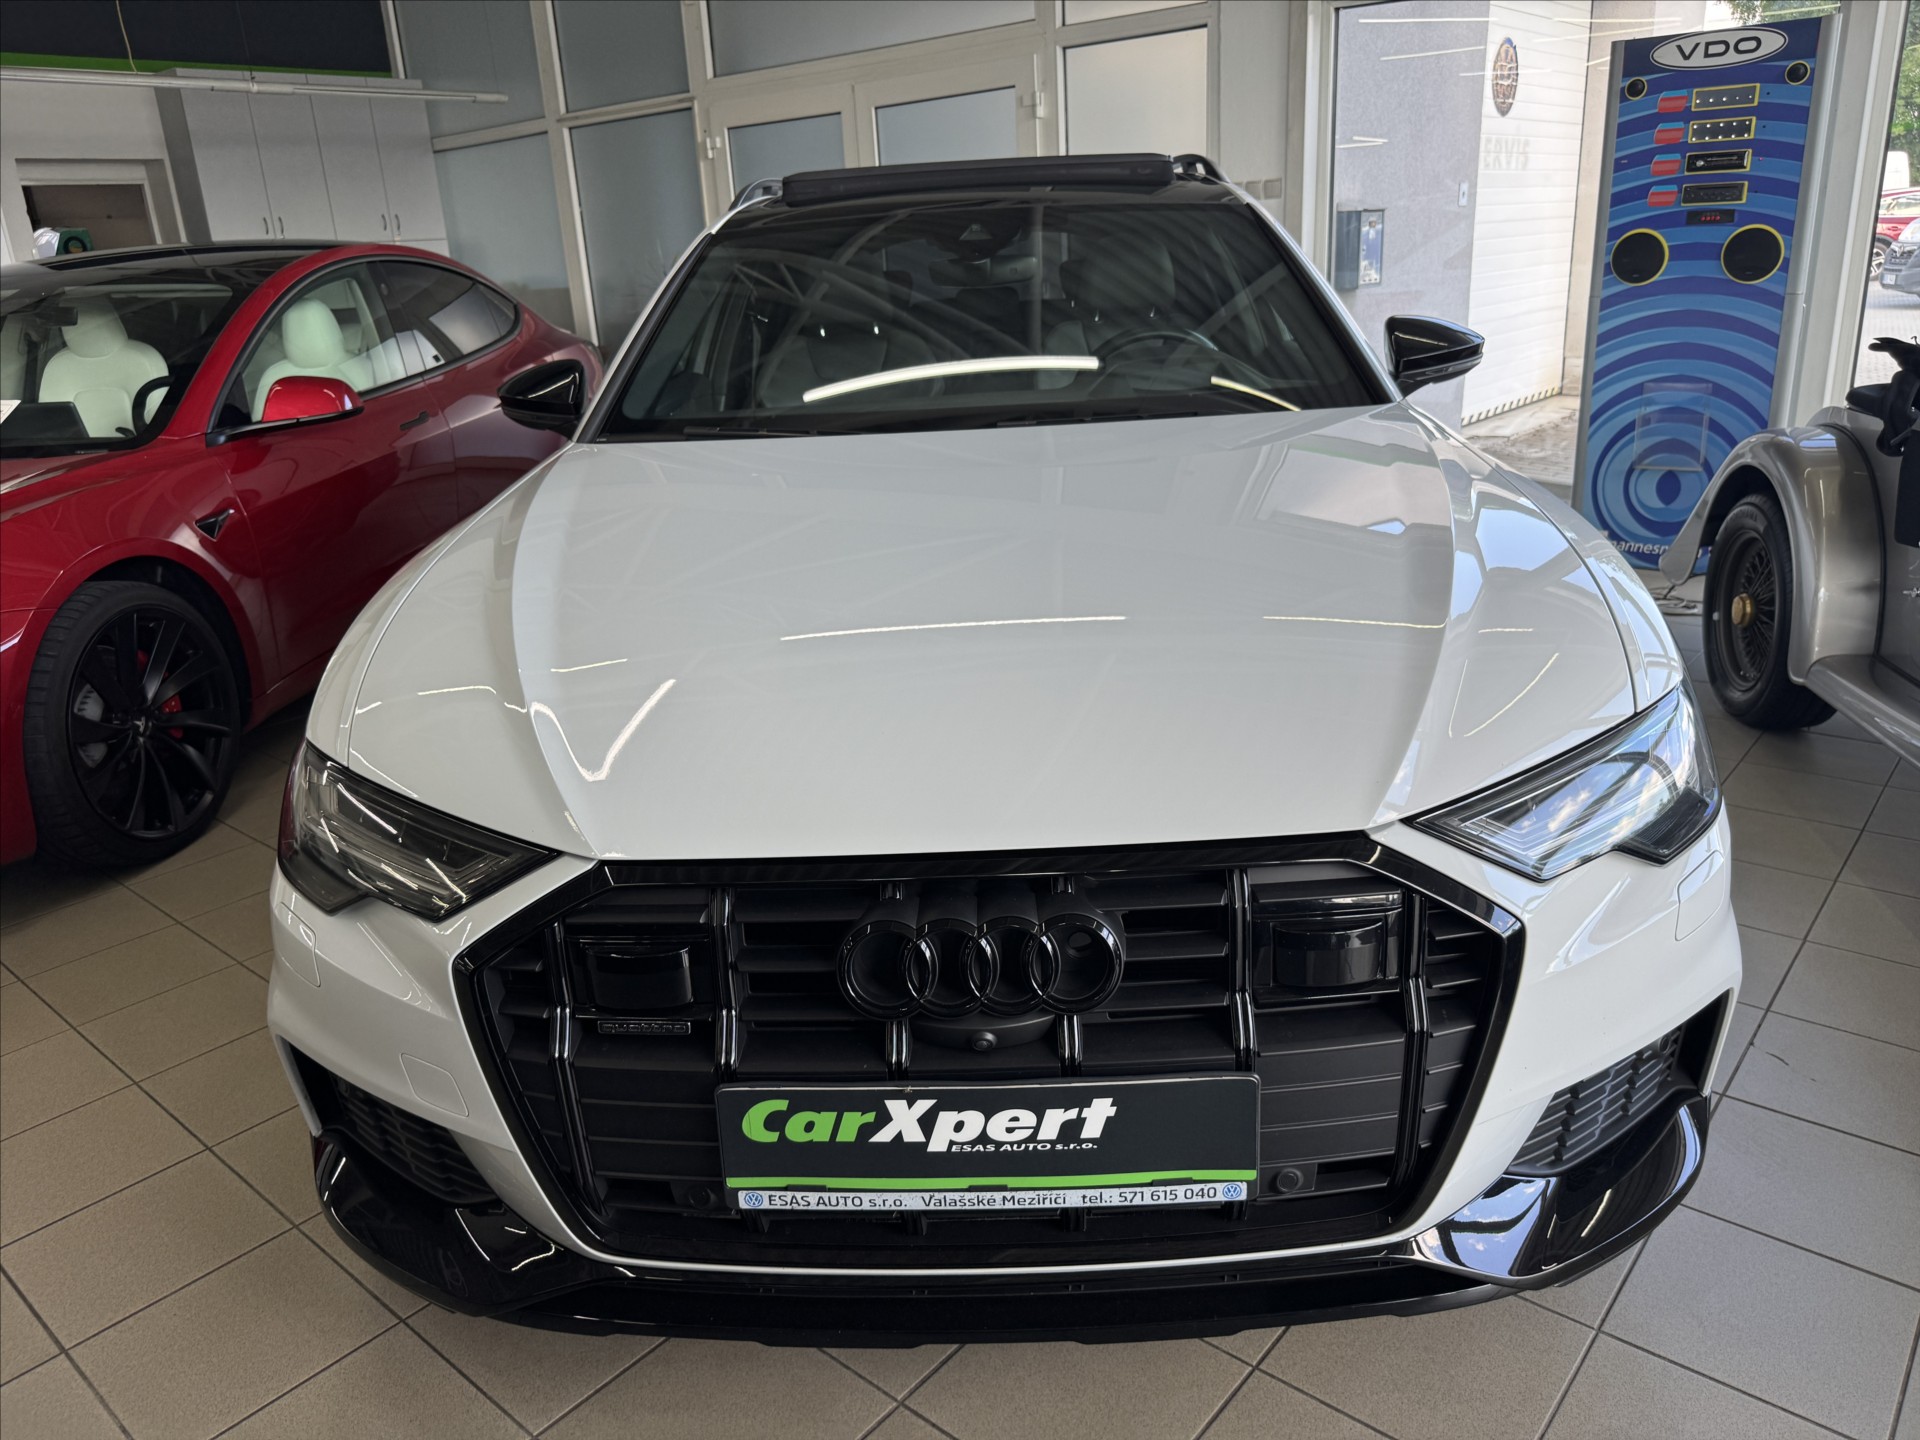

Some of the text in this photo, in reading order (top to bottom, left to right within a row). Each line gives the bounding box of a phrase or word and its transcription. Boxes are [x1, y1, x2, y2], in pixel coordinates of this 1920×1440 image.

[1676, 36, 1762, 61] VDO
[601, 1023, 686, 1033] quattro
[742, 1098, 1117, 1152] CarXpert
[951, 1142, 1098, 1152] ESAS AUTO s.r.o.
[768, 1186, 1217, 1208] ESAS AUTO s.r.o. Valašské Meziříčí tel.: 571 615 040
